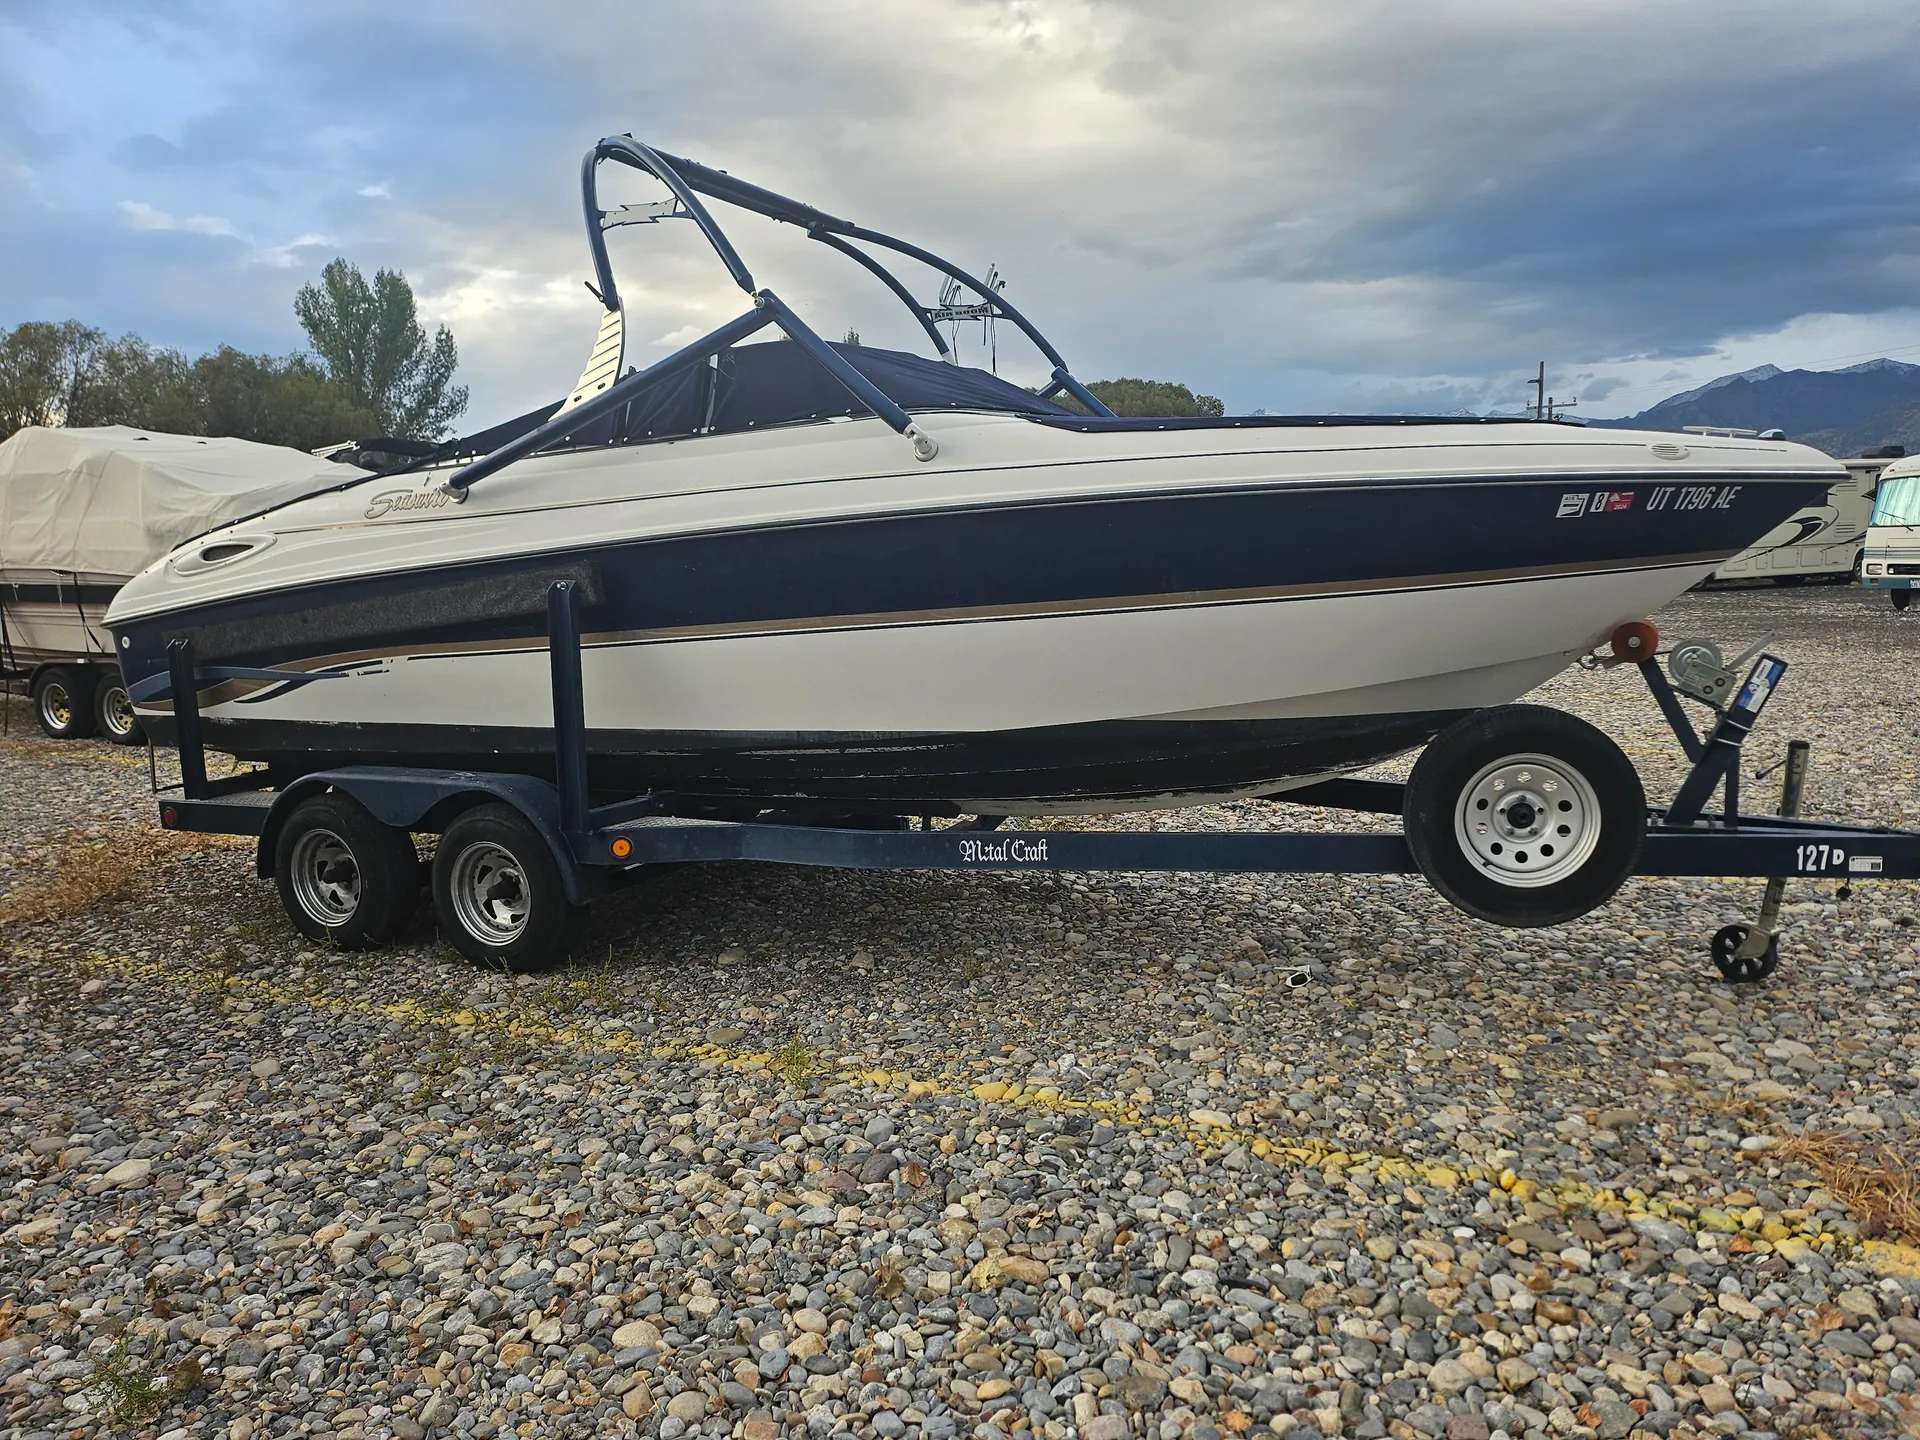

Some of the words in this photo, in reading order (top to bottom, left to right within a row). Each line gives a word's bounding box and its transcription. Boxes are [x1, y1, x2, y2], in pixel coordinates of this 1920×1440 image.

[1646, 486, 1676, 511] UT
[1673, 486, 1717, 510] 1796
[1711, 486, 1743, 509] AE
[959, 838, 1010, 862] Metal
[1011, 838, 1048, 862] Craft
